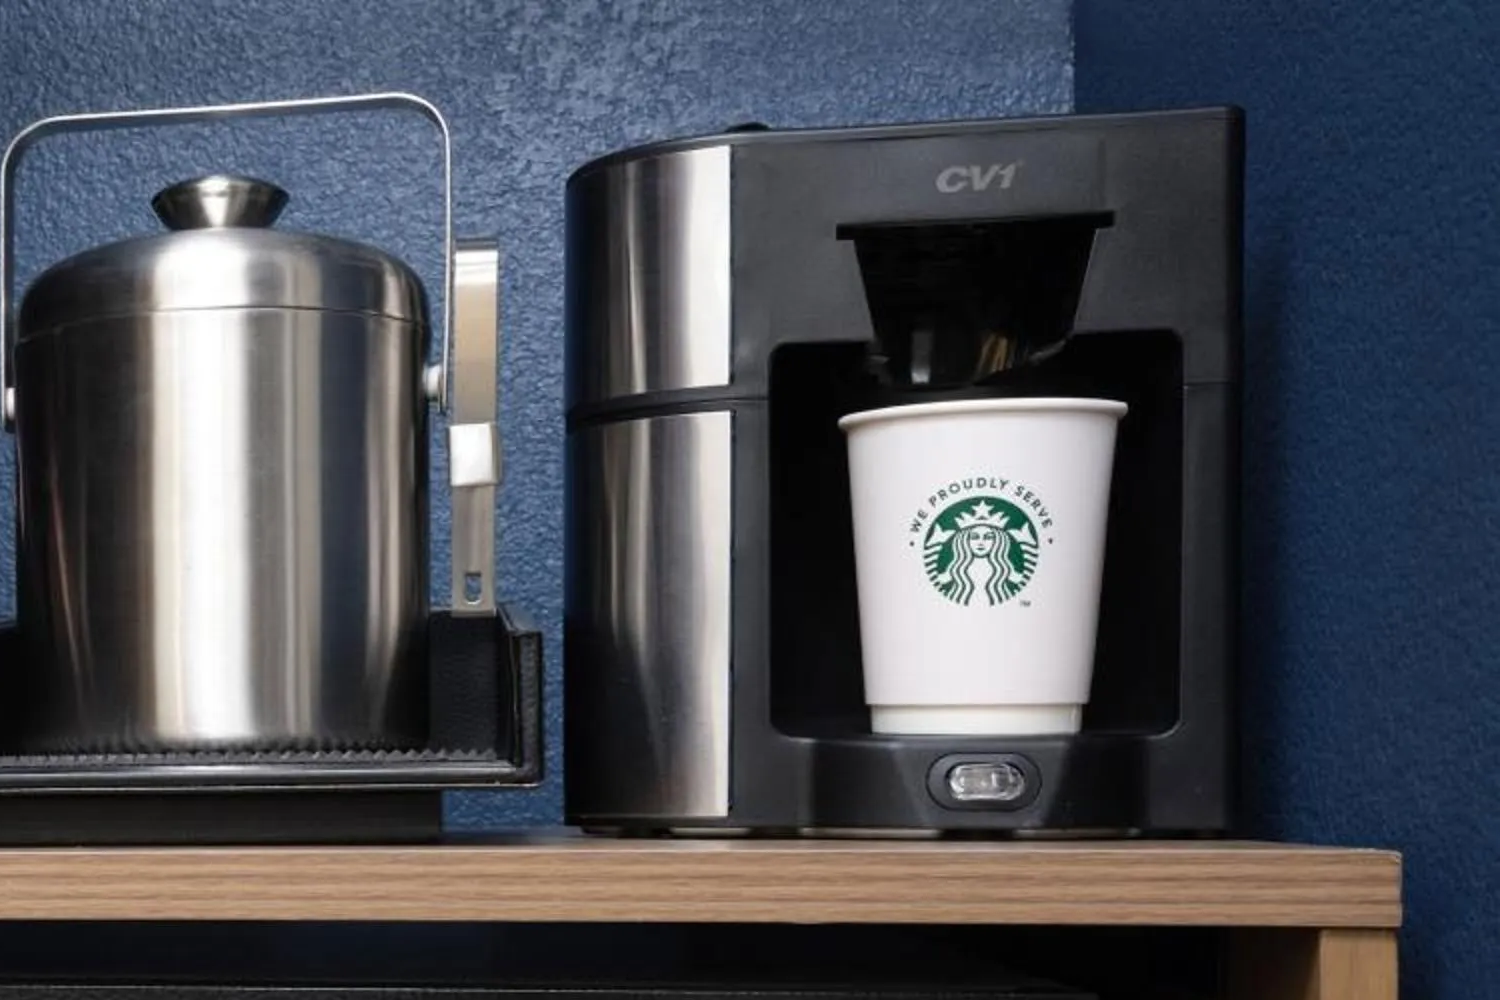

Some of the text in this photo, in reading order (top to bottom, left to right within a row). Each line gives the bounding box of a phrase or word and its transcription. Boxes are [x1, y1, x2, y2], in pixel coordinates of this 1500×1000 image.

[935, 163, 1016, 193] CV1
[910, 477, 1053, 533] WE PROUDLY SERVE
